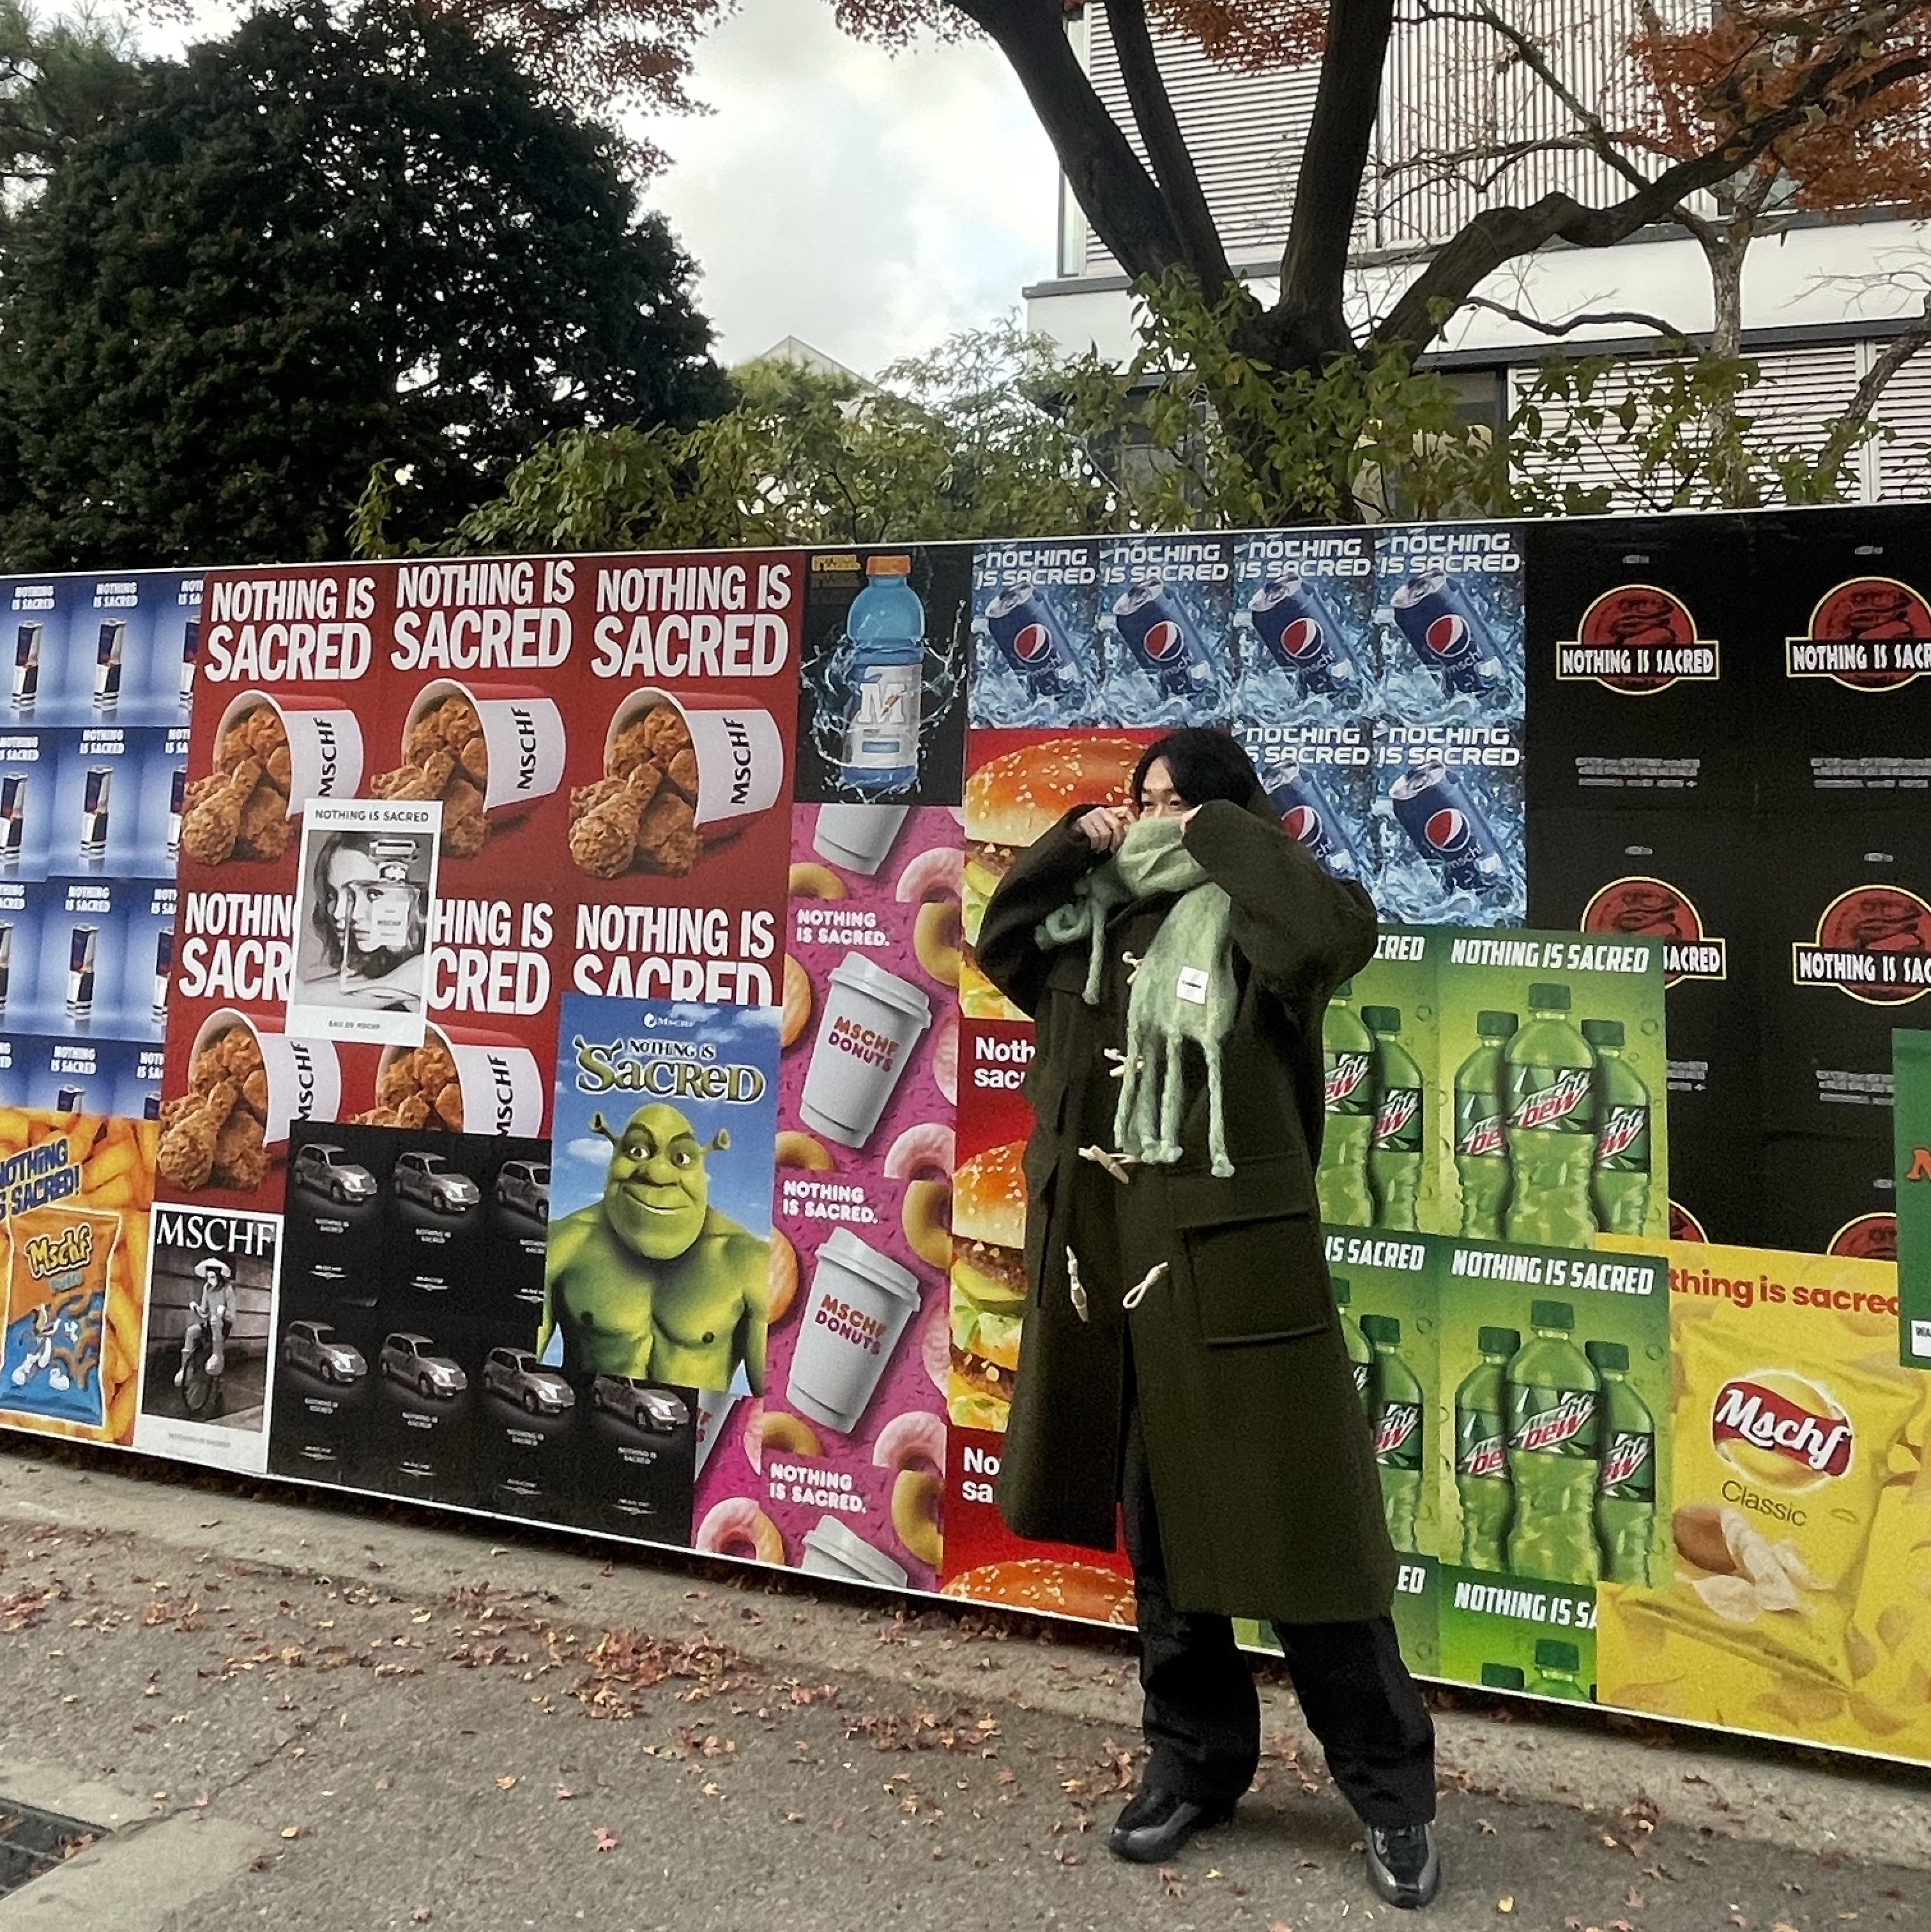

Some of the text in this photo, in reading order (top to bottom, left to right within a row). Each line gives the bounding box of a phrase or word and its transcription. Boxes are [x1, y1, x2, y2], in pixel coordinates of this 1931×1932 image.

[397, 560, 574, 608] NOTHING IS
[978, 567, 1095, 588] IS SACRED
[1106, 564, 1228, 583] IS SACRED
[1240, 558, 1372, 579] IS SACRED
[1381, 553, 1520, 576] IS SACRED
[211, 578, 375, 622] NOTHING IS
[596, 565, 791, 613] NOTHING IS
[204, 623, 372, 681] SACRED
[391, 607, 572, 670] SACRED
[591, 614, 789, 678] SACRED
[1792, 644, 1868, 670] NOTHING
[1874, 644, 1888, 670] IS
[1562, 648, 1714, 674] NOTHING IS SACRED
[312, 717, 337, 797] MSCHF
[510, 707, 537, 790] MSCHF
[722, 717, 751, 804] MSCHF
[1264, 746, 1371, 765] SACRED
[1379, 746, 1520, 767] IS SACRED
[315, 809, 429, 822] NOTHING IS SACRED
[185, 892, 298, 937] NOTHIN
[434, 900, 553, 949] HING IS
[576, 904, 775, 958] NOTHING IS
[797, 908, 877, 928] NOTHING
[797, 927, 891, 947] IS SACRED.
[1451, 938, 1650, 973] NOTHING IS SACRED
[427, 947, 551, 1015] CRED
[573, 954, 772, 1007] SACRED
[1800, 951, 1877, 981] NOTHING
[1882, 956, 1896, 983] IS
[628, 1038, 716, 1061] NOTHING IS
[829, 1031, 894, 1073] DONUTS
[834, 1016, 900, 1055] MSCHF
[782, 1197, 879, 1225] IS SACRED.
[783, 1179, 865, 1202] NOTHING
[26, 1223, 92, 1278] Mschf
[156, 1213, 275, 1257] MSCHF
[1347, 1238, 1425, 1271] SACRED
[1451, 1249, 1656, 1296] NOTHING IS SACRED
[1760, 1275, 1787, 1305] is
[814, 1310, 883, 1356] DONUTS
[820, 1293, 888, 1338] MSCHF
[1715, 1388, 1851, 1470] Mschf
[770, 1462, 853, 1492] NOTHING
[770, 1481, 867, 1514] IS SACRED.
[1721, 1480, 1808, 1528] Classic
[1454, 1582, 1546, 1623] NOTHING
[1550, 1597, 1571, 1626] IS
